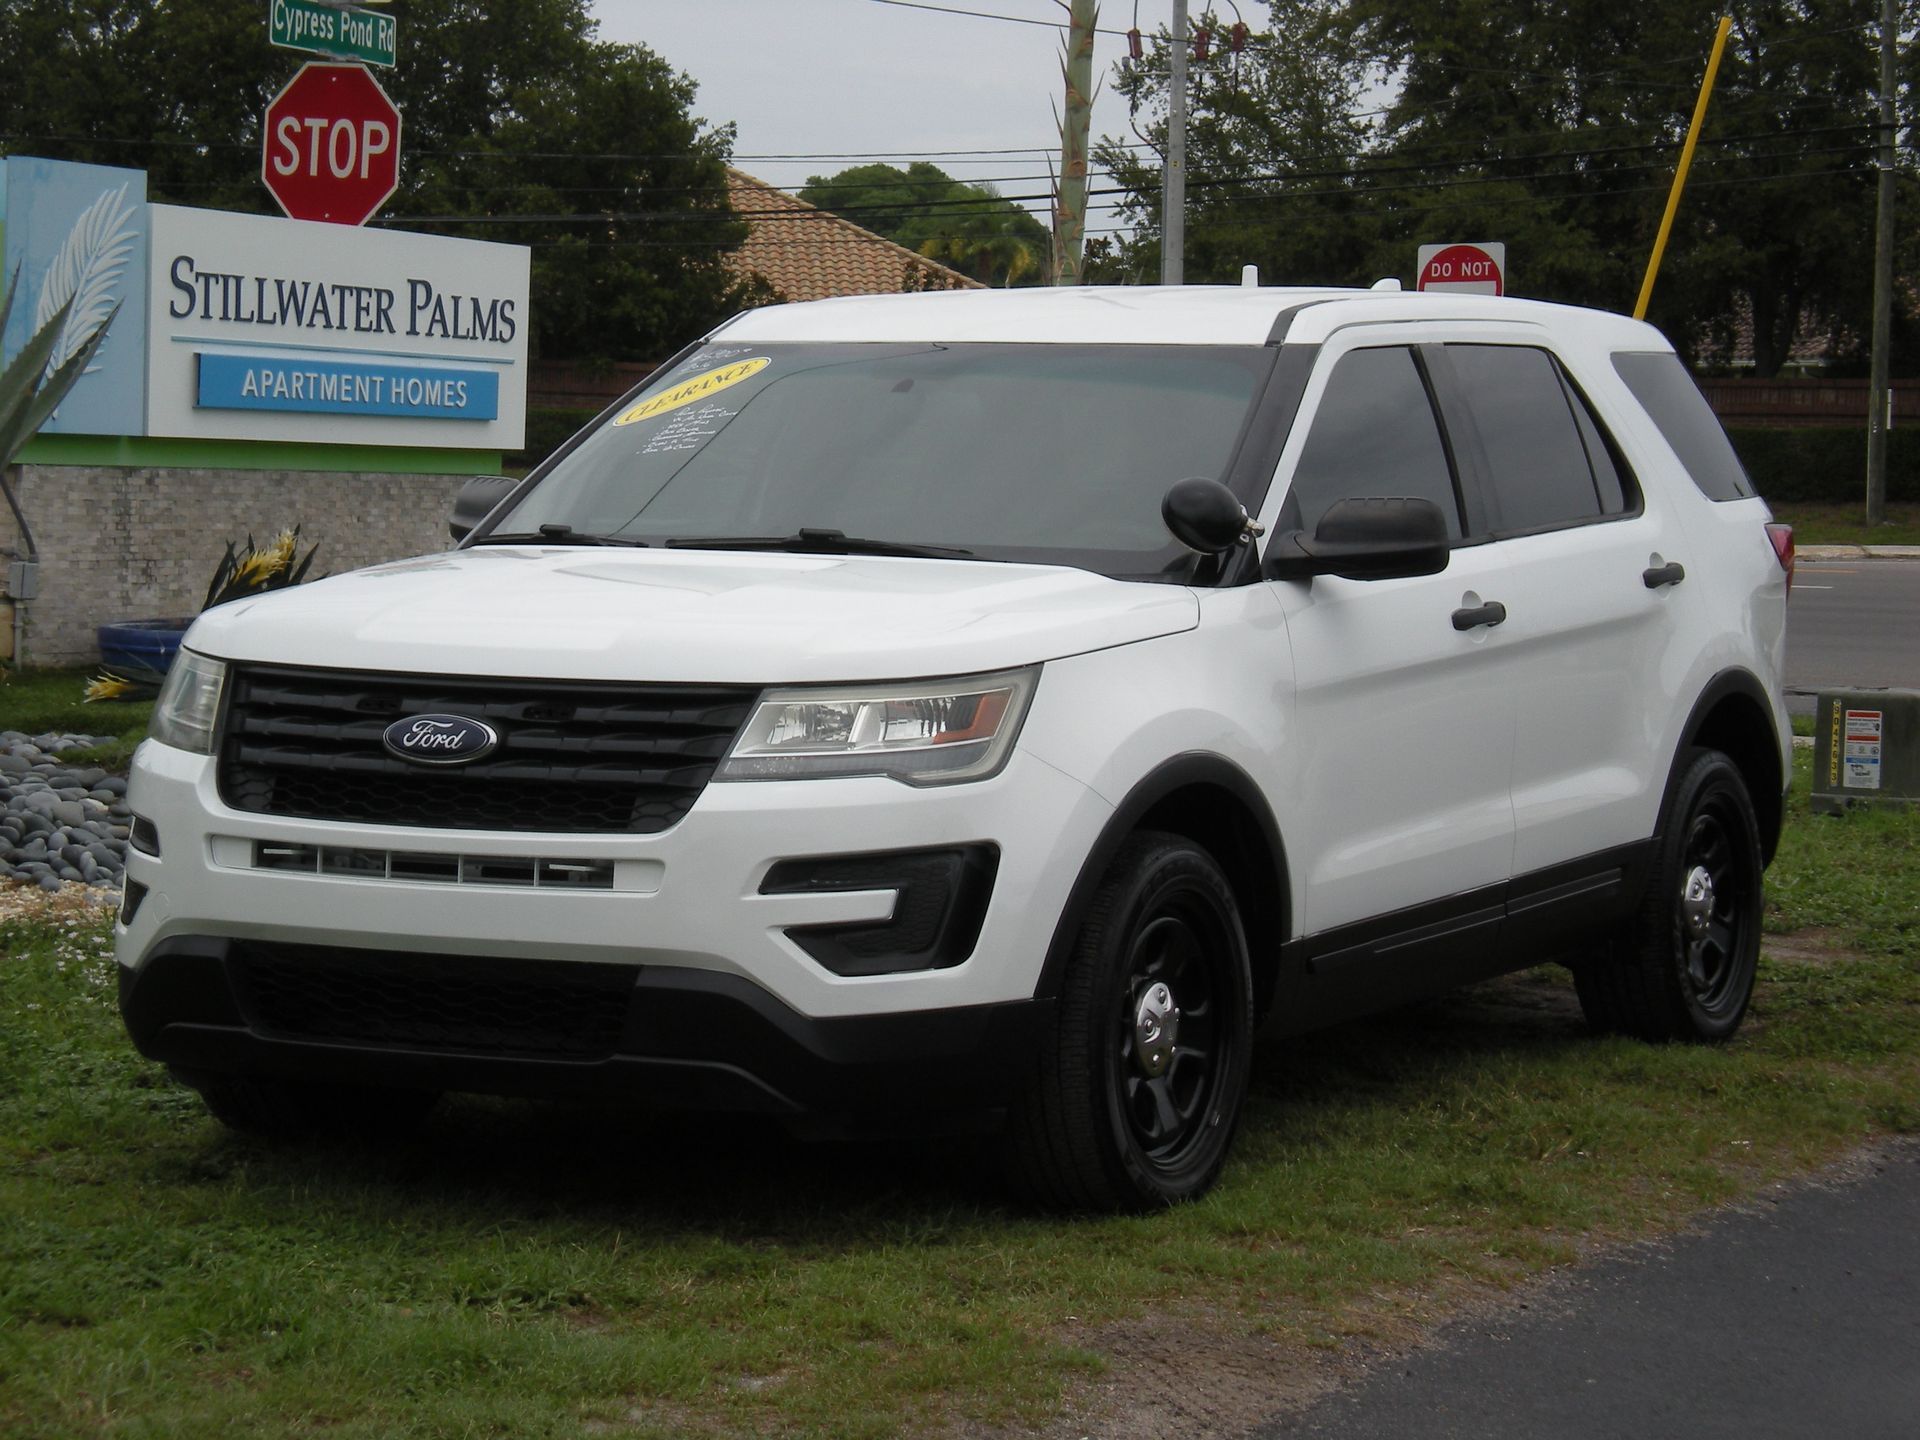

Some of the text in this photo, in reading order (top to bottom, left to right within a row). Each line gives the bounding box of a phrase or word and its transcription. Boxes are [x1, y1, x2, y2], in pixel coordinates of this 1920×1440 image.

[274, 0, 394, 52] Cypress Pond Rd
[273, 116, 390, 179] STOP
[1431, 262, 1492, 277] DO NOT
[169, 255, 516, 343] STILLWATER PALMS
[241, 369, 467, 408] APARTMENT HOMES
[403, 720, 467, 749] Ford
